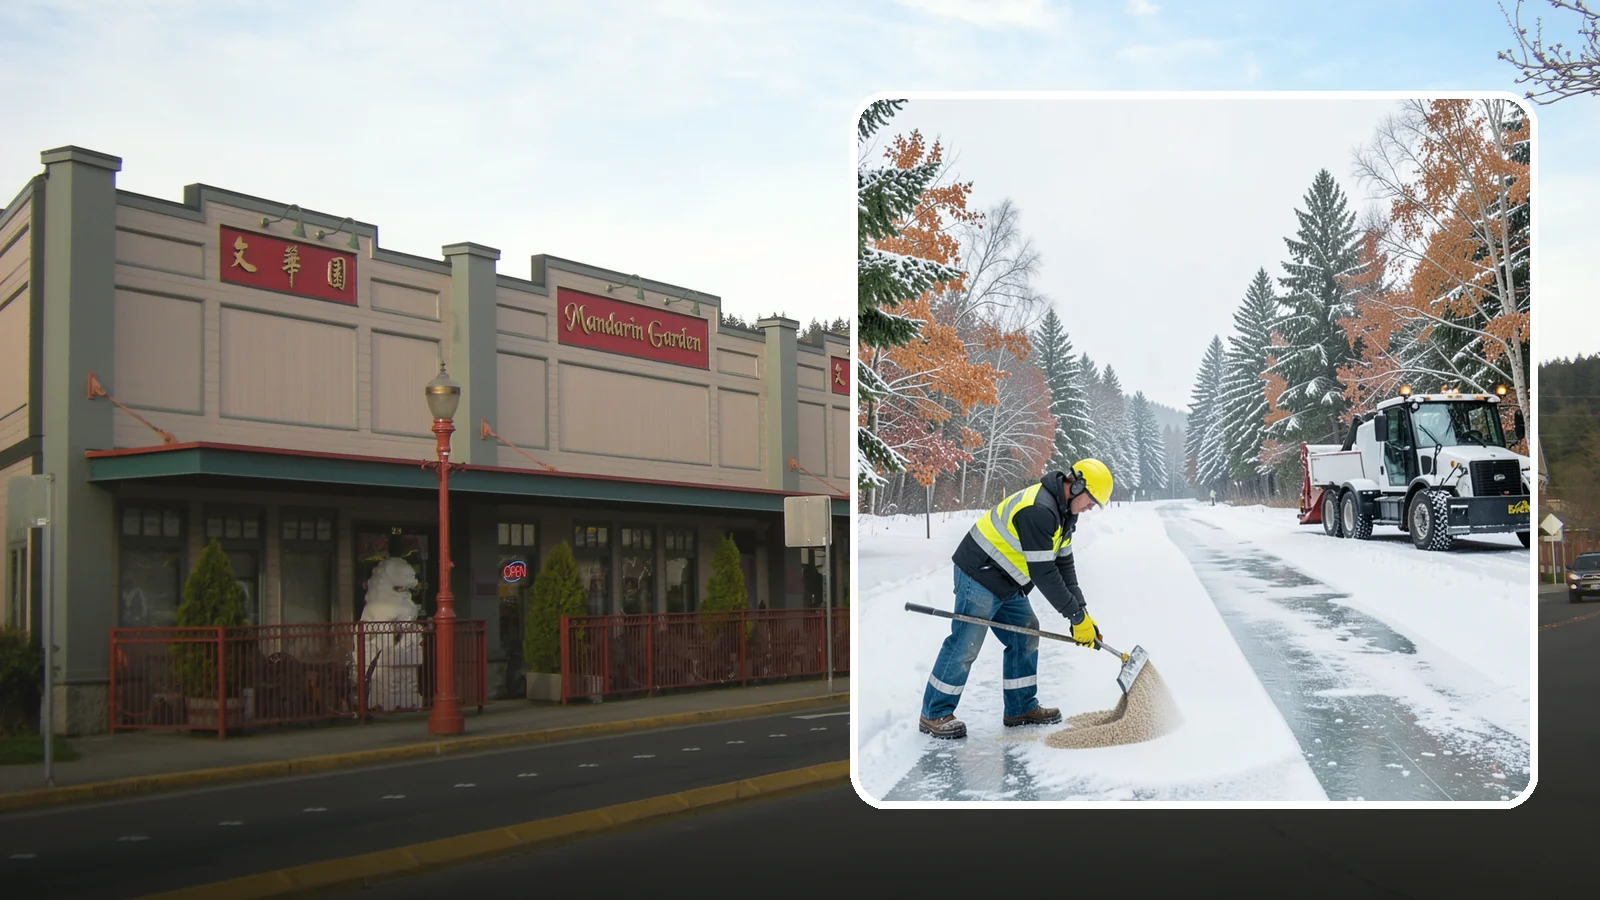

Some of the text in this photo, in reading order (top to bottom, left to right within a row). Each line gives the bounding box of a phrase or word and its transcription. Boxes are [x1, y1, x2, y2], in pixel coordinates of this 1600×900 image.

[231, 235, 346, 291] 文華園
[564, 302, 702, 352] Mandarin Garden
[503, 565, 527, 578] OPEN
